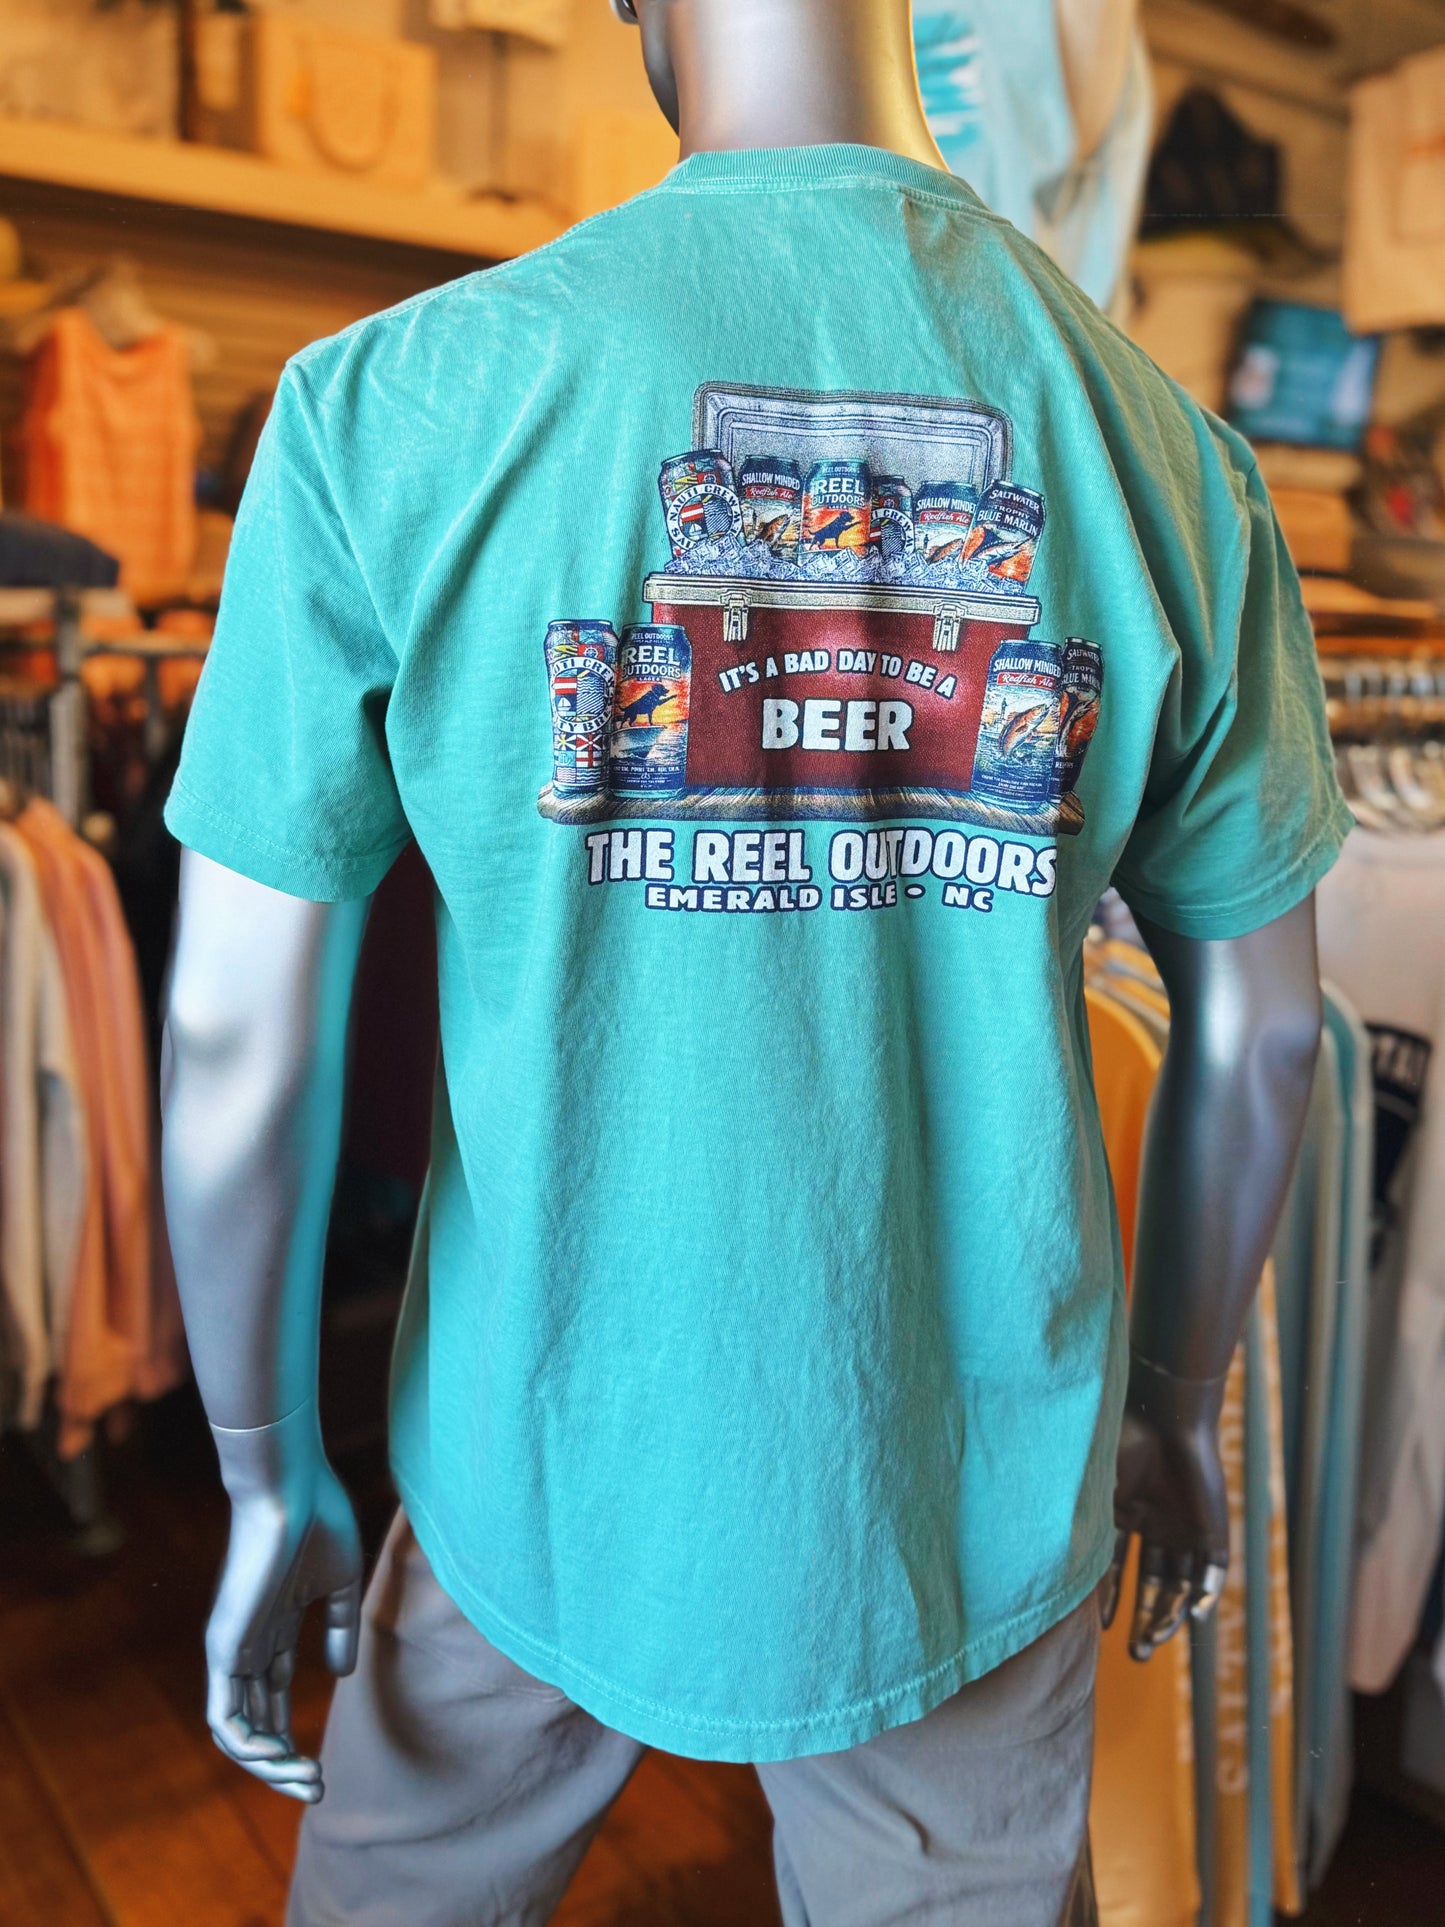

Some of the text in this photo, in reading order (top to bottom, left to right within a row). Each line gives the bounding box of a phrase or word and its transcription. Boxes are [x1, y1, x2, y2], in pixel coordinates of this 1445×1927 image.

[741, 472, 800, 490] SHALLOW MINDED
[814, 477, 865, 496] REEL
[780, 490, 793, 499] Ale
[811, 494, 865, 507] OUTDOORS
[916, 497, 950, 511] SHALLOW
[989, 489, 1040, 514] SALTWATER
[956, 514, 970, 524] Ale
[994, 504, 1030, 520] TROPHY
[977, 510, 1003, 522] BLUE
[1003, 514, 1039, 536] MARLIN
[623, 645, 681, 666] REEL
[718, 649, 958, 699] IT'S A BAD DAY TO BE A
[993, 658, 1061, 677] SHALLOW MINDED
[1001, 673, 1053, 688] Redfish Ale
[761, 697, 914, 752] BEER
[585, 826, 1058, 898] THE REEL OUTDOORS
[645, 883, 822, 913] EMERALD
[830, 881, 898, 912] ISLE
[941, 881, 995, 913] NC
